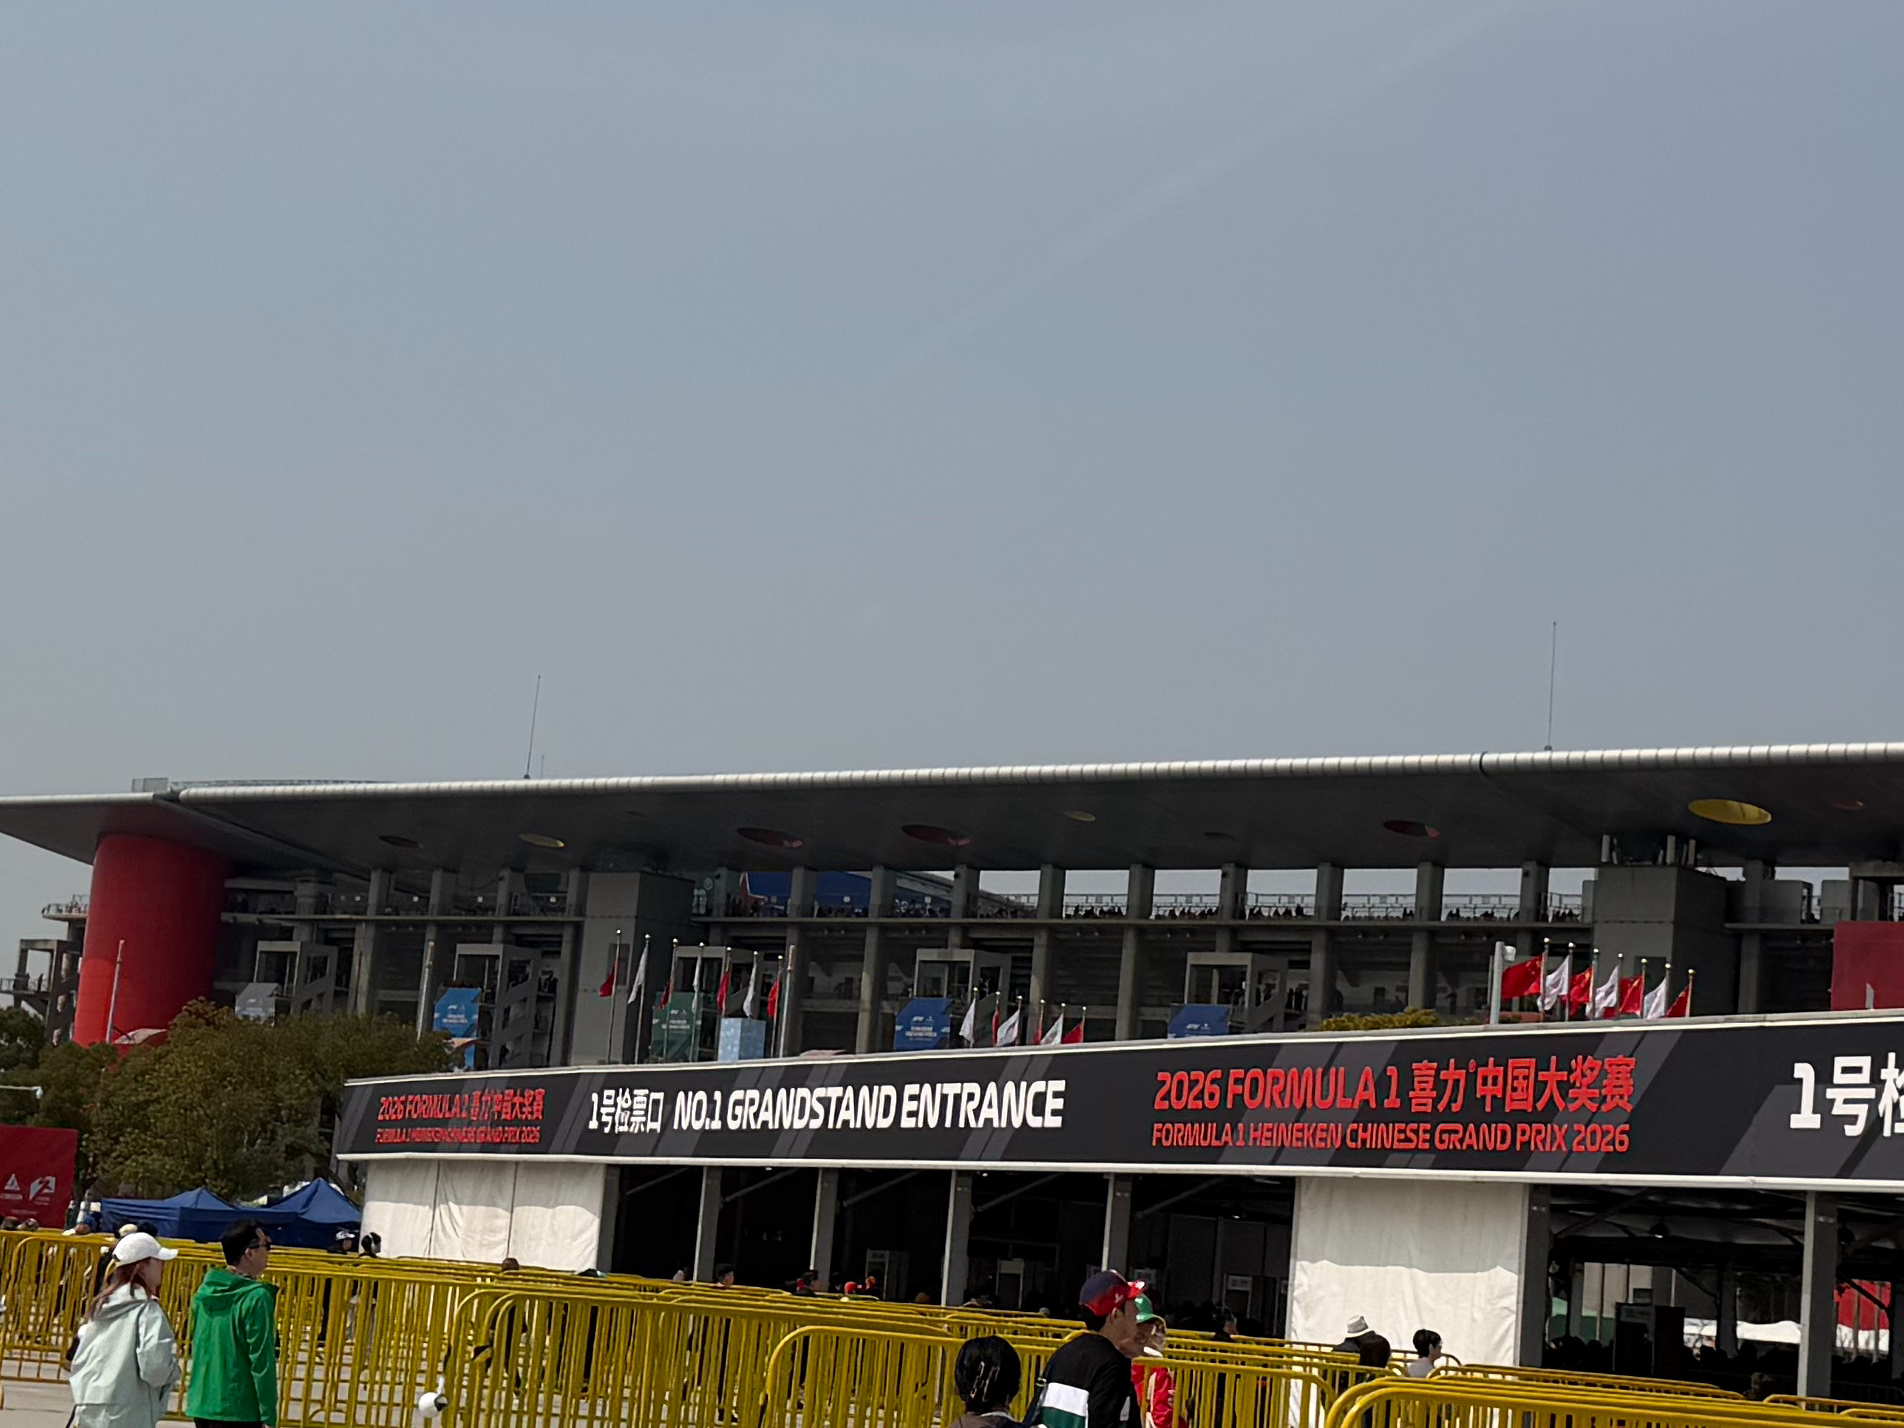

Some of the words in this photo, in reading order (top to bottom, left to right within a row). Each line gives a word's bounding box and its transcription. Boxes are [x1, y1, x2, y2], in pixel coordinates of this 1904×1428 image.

[588, 1088, 664, 1133] 1号检票口
[672, 1090, 722, 1130] NO.1
[726, 1085, 896, 1130] GRANDSTAND
[900, 1079, 1066, 1129] ENTRANCE
[1153, 1071, 1224, 1110] 2026
[1226, 1067, 1377, 1110] FORMULA
[1383, 1066, 1402, 1109] 1
[1152, 1122, 1234, 1149] FORMULA
[1235, 1123, 1246, 1148] 1
[1248, 1123, 1342, 1150] HEINEKEN
[1346, 1123, 1431, 1151] CHINESE
[1435, 1123, 1512, 1152] GRAND
[1518, 1124, 1568, 1153] PRIX
[1572, 1124, 1631, 1154] 2026
